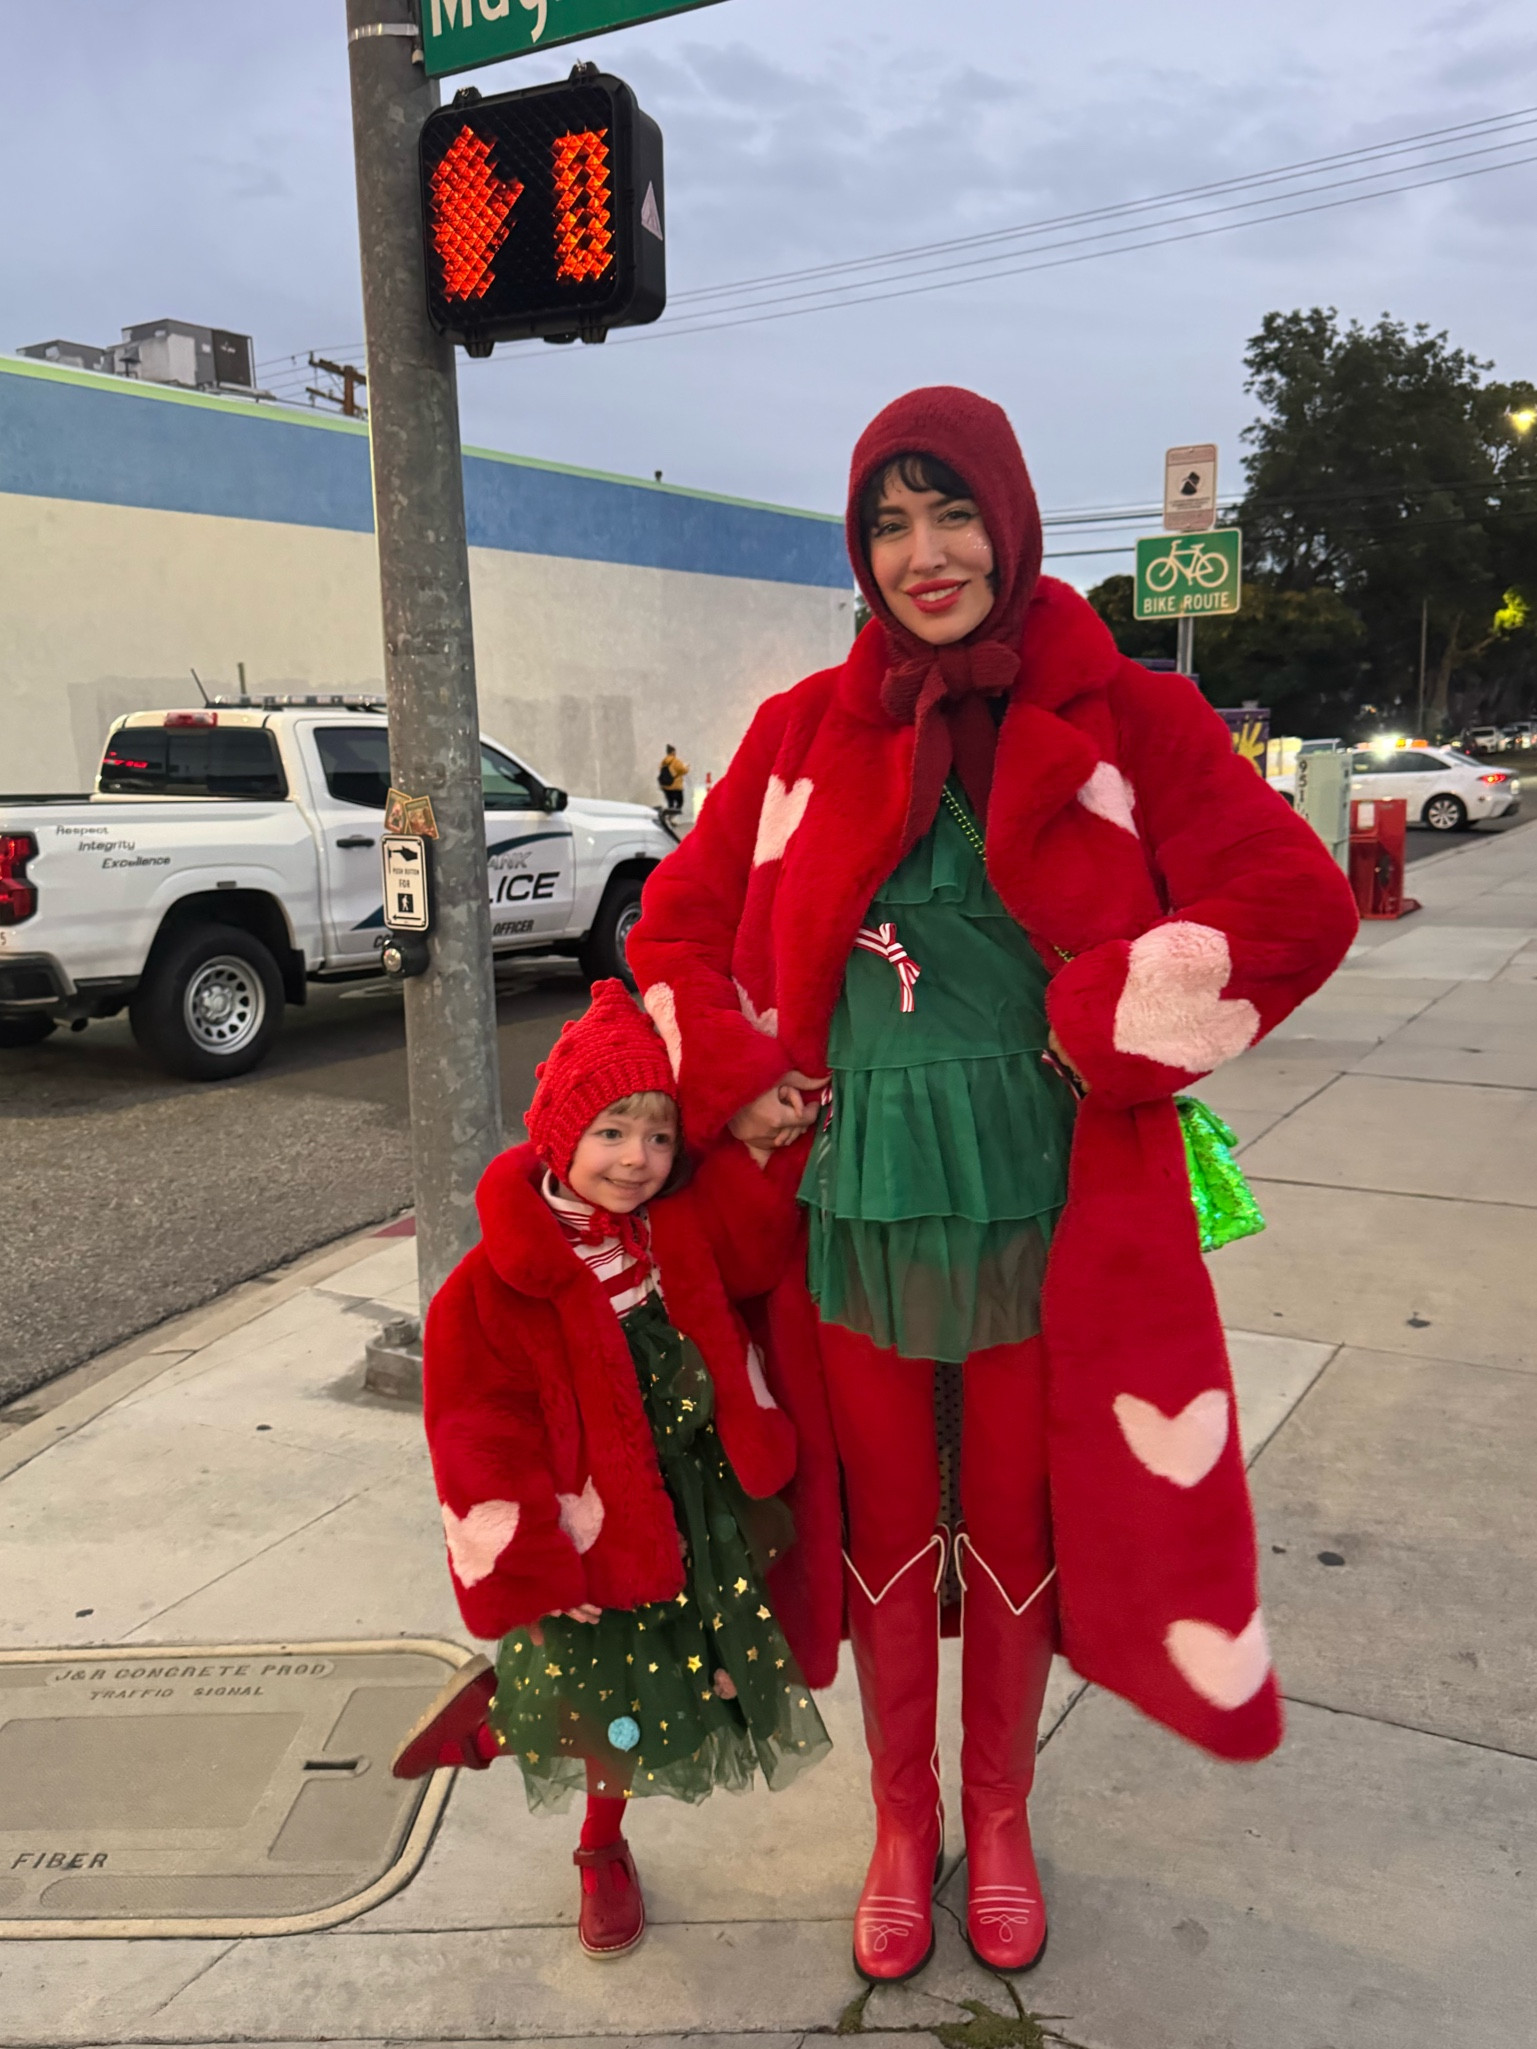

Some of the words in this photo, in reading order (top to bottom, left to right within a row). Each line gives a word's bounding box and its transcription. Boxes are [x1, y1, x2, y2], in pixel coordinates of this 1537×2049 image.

[1143, 596, 1176, 614] BIKE
[1183, 592, 1230, 610] ROUTE
[56, 825, 109, 836] Respect
[78, 840, 136, 852] Integrity
[102, 856, 171, 869] Excellence
[392, 867, 404, 875] PUSH
[404, 867, 420, 876] BUTTON
[398, 878, 411, 888] FOR
[489, 871, 560, 903] ICE
[493, 919, 535, 935] OFFICER
[55, 1668, 107, 1681] J&R
[114, 1664, 251, 1680] CONCRETE
[261, 1664, 327, 1676] PROD
[90, 1687, 175, 1700] TRAFFIC
[193, 1686, 264, 1697] SIGNAL
[10, 1852, 109, 1870] FIBER
